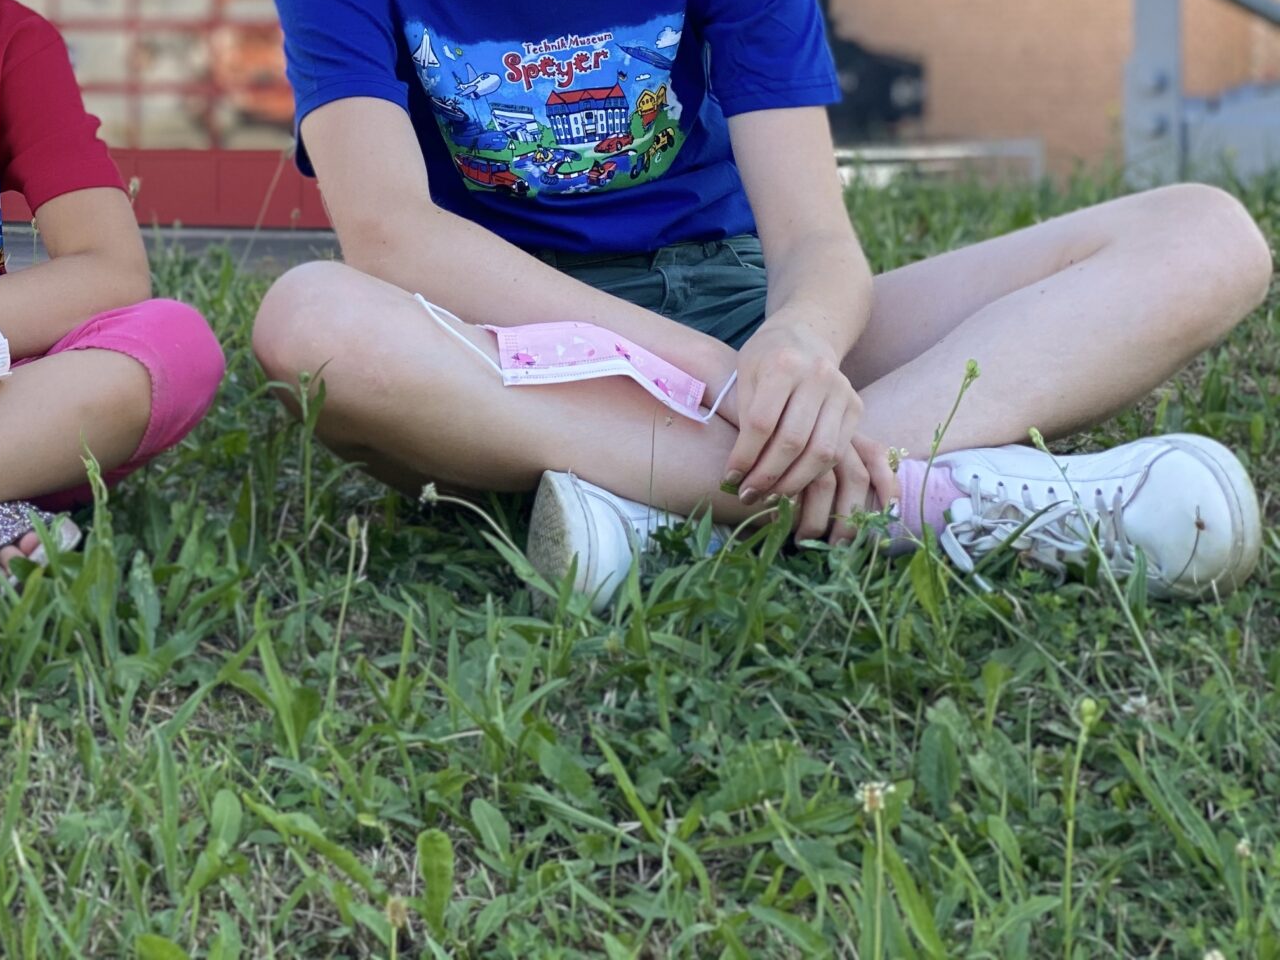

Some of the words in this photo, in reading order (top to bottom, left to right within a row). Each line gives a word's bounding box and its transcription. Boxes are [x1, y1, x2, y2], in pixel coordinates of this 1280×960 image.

[524, 37, 568, 55] Technik
[569, 33, 613, 48] Museum
[503, 50, 609, 90] Speyer
